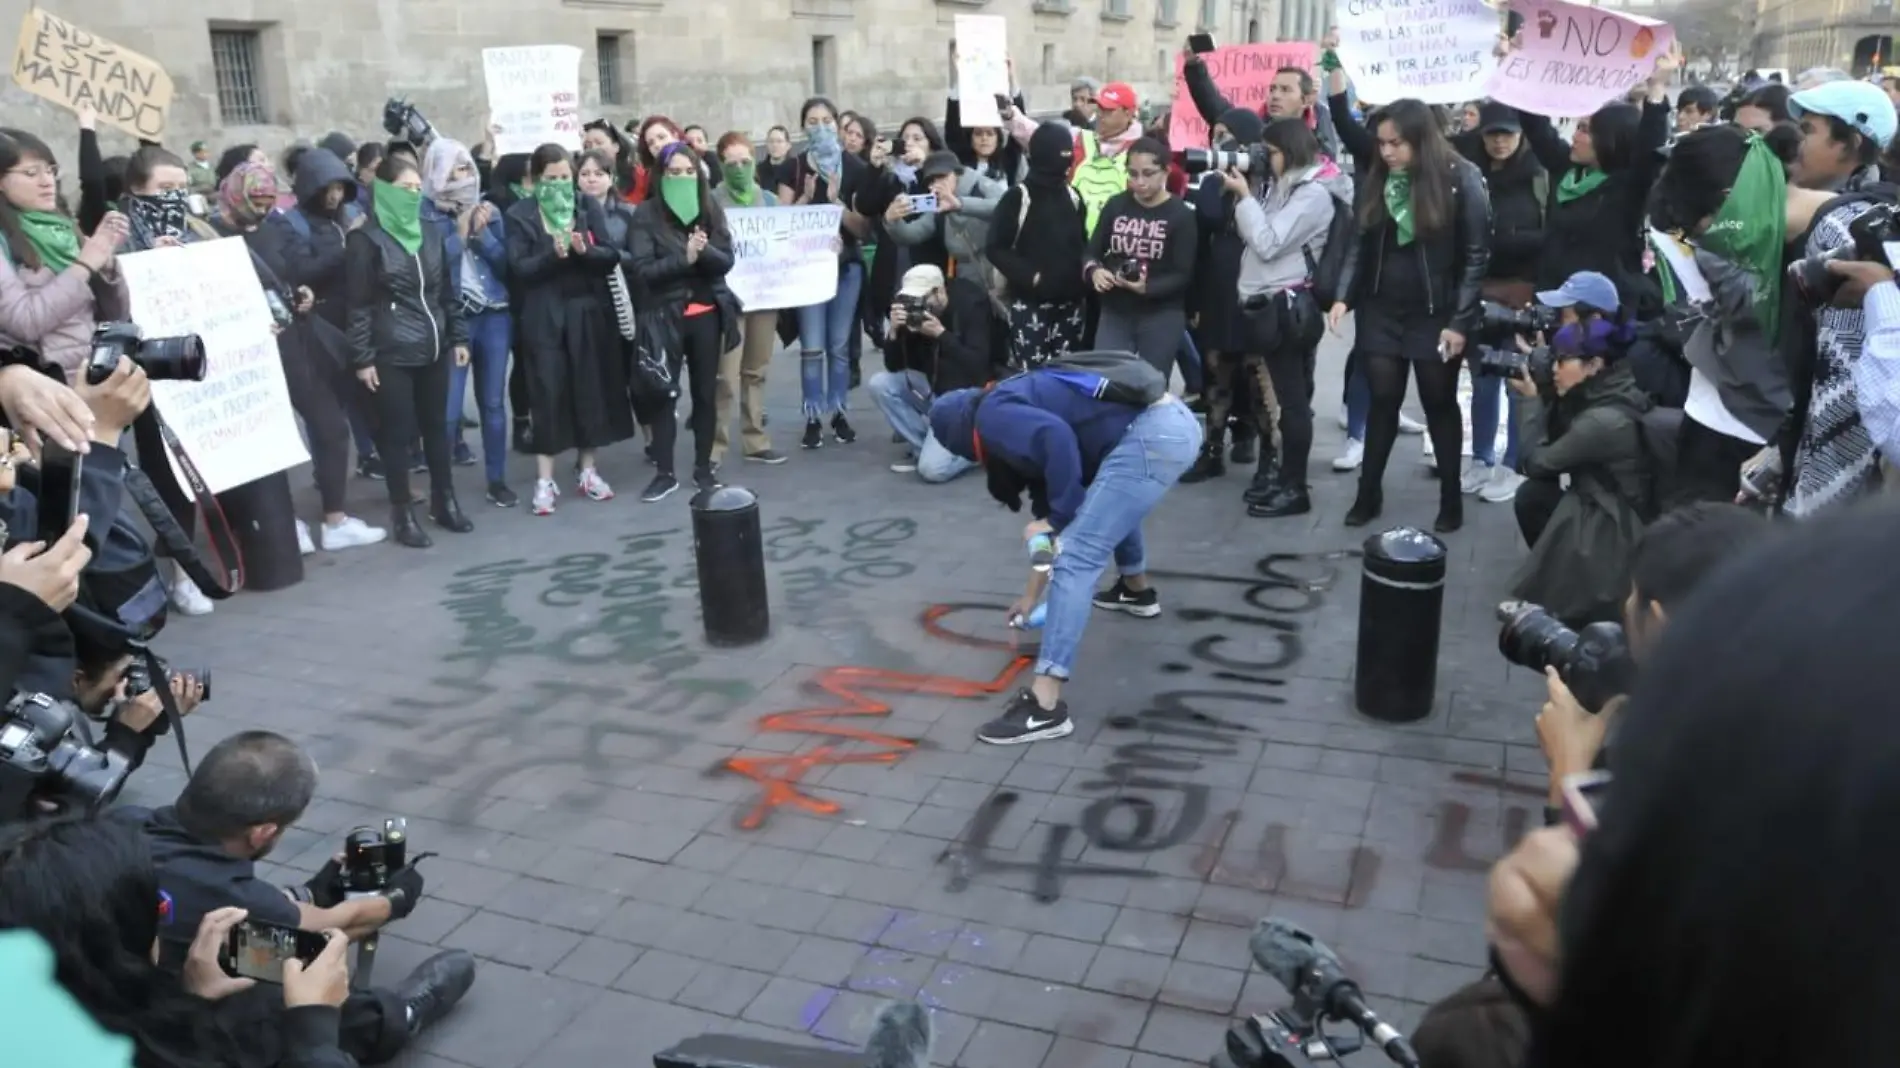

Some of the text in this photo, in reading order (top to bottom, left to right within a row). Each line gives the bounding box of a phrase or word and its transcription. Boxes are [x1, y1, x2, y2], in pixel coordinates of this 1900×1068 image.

[1388, 25, 1413, 41] LAS
[1561, 14, 1622, 58] NO
[1424, 55, 1449, 69] LAS
[1505, 57, 1536, 80] ES
[15, 48, 166, 137] MATANDO
[728, 214, 777, 239] STADO
[790, 209, 840, 233] ESTADO
[1113, 215, 1169, 239] GAME
[1110, 233, 1165, 260] OVER
[836, 515, 919, 588] Que
